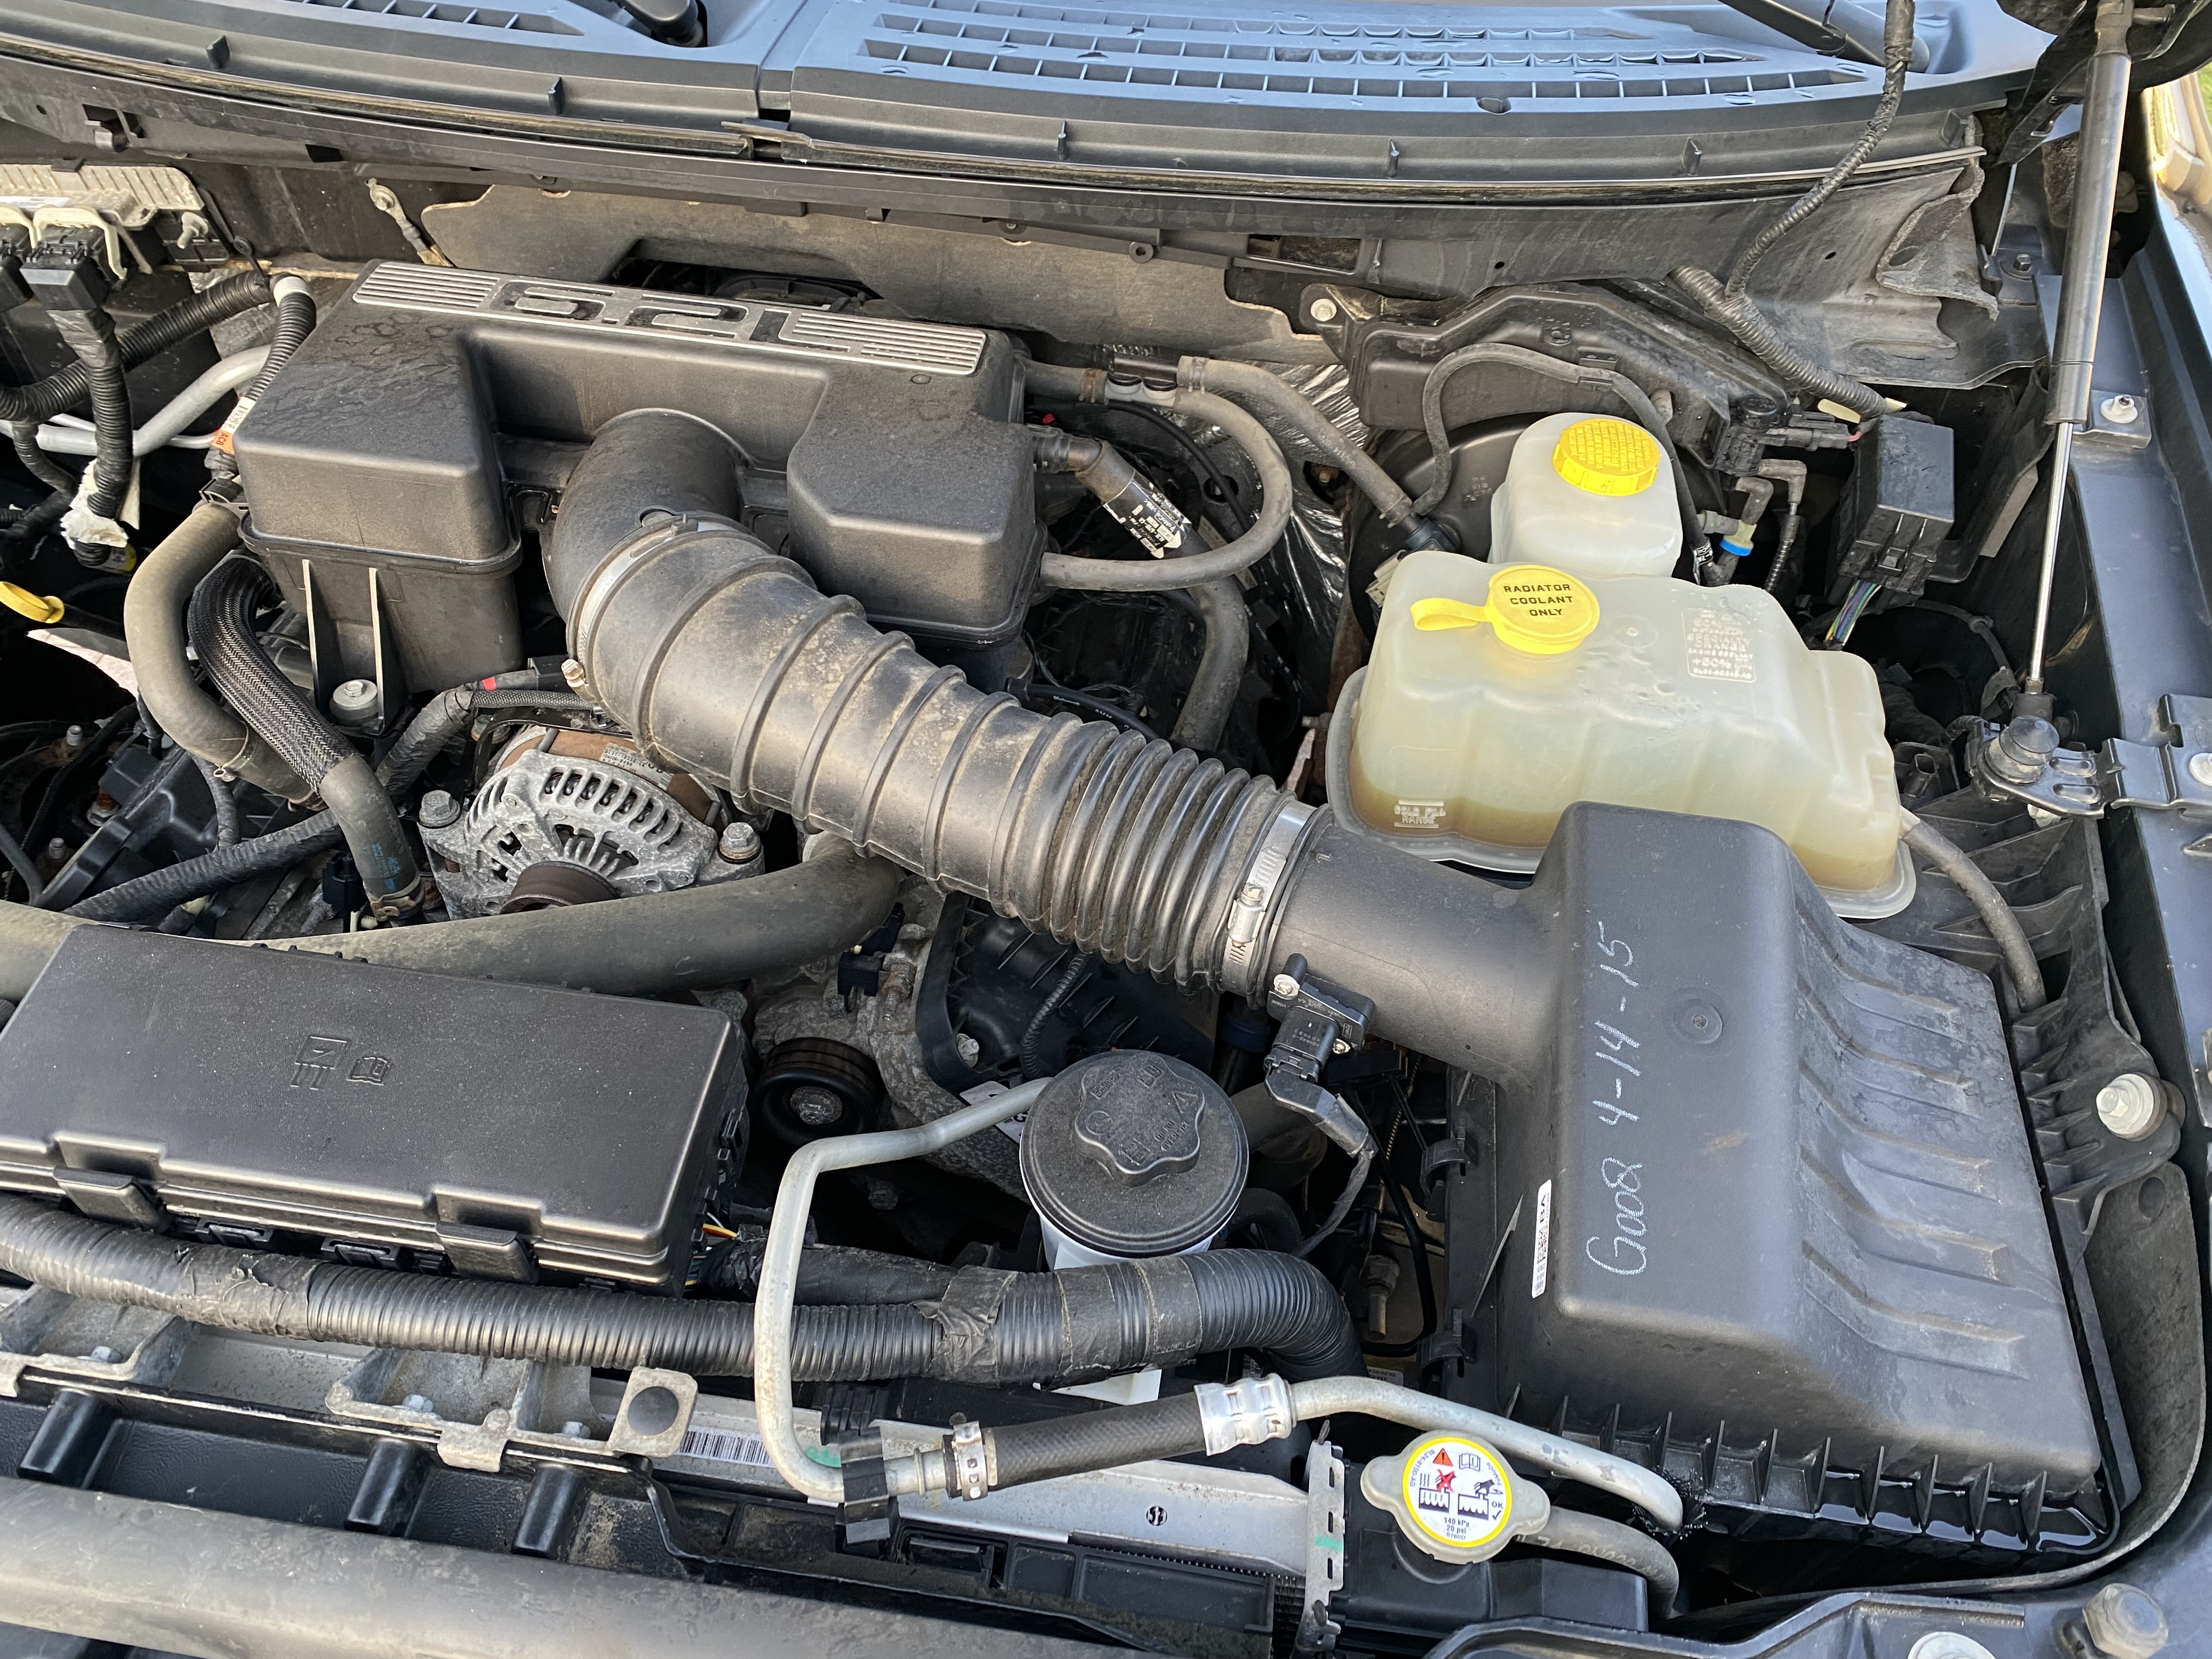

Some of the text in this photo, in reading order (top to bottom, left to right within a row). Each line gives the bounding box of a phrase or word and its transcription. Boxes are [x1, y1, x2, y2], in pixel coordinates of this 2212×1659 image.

[488, 279, 850, 352] 6.2L
[216, 432, 229, 446] AC8
[1503, 584, 1571, 593] RADIATOR
[1509, 596, 1573, 605] COOLANT
[1529, 608, 1562, 617] ONLY
[1487, 1462, 1502, 1486] FoMoCo
[1492, 1501, 1503, 1509] OK
[1444, 1516, 1469, 1527] 140 kPa
